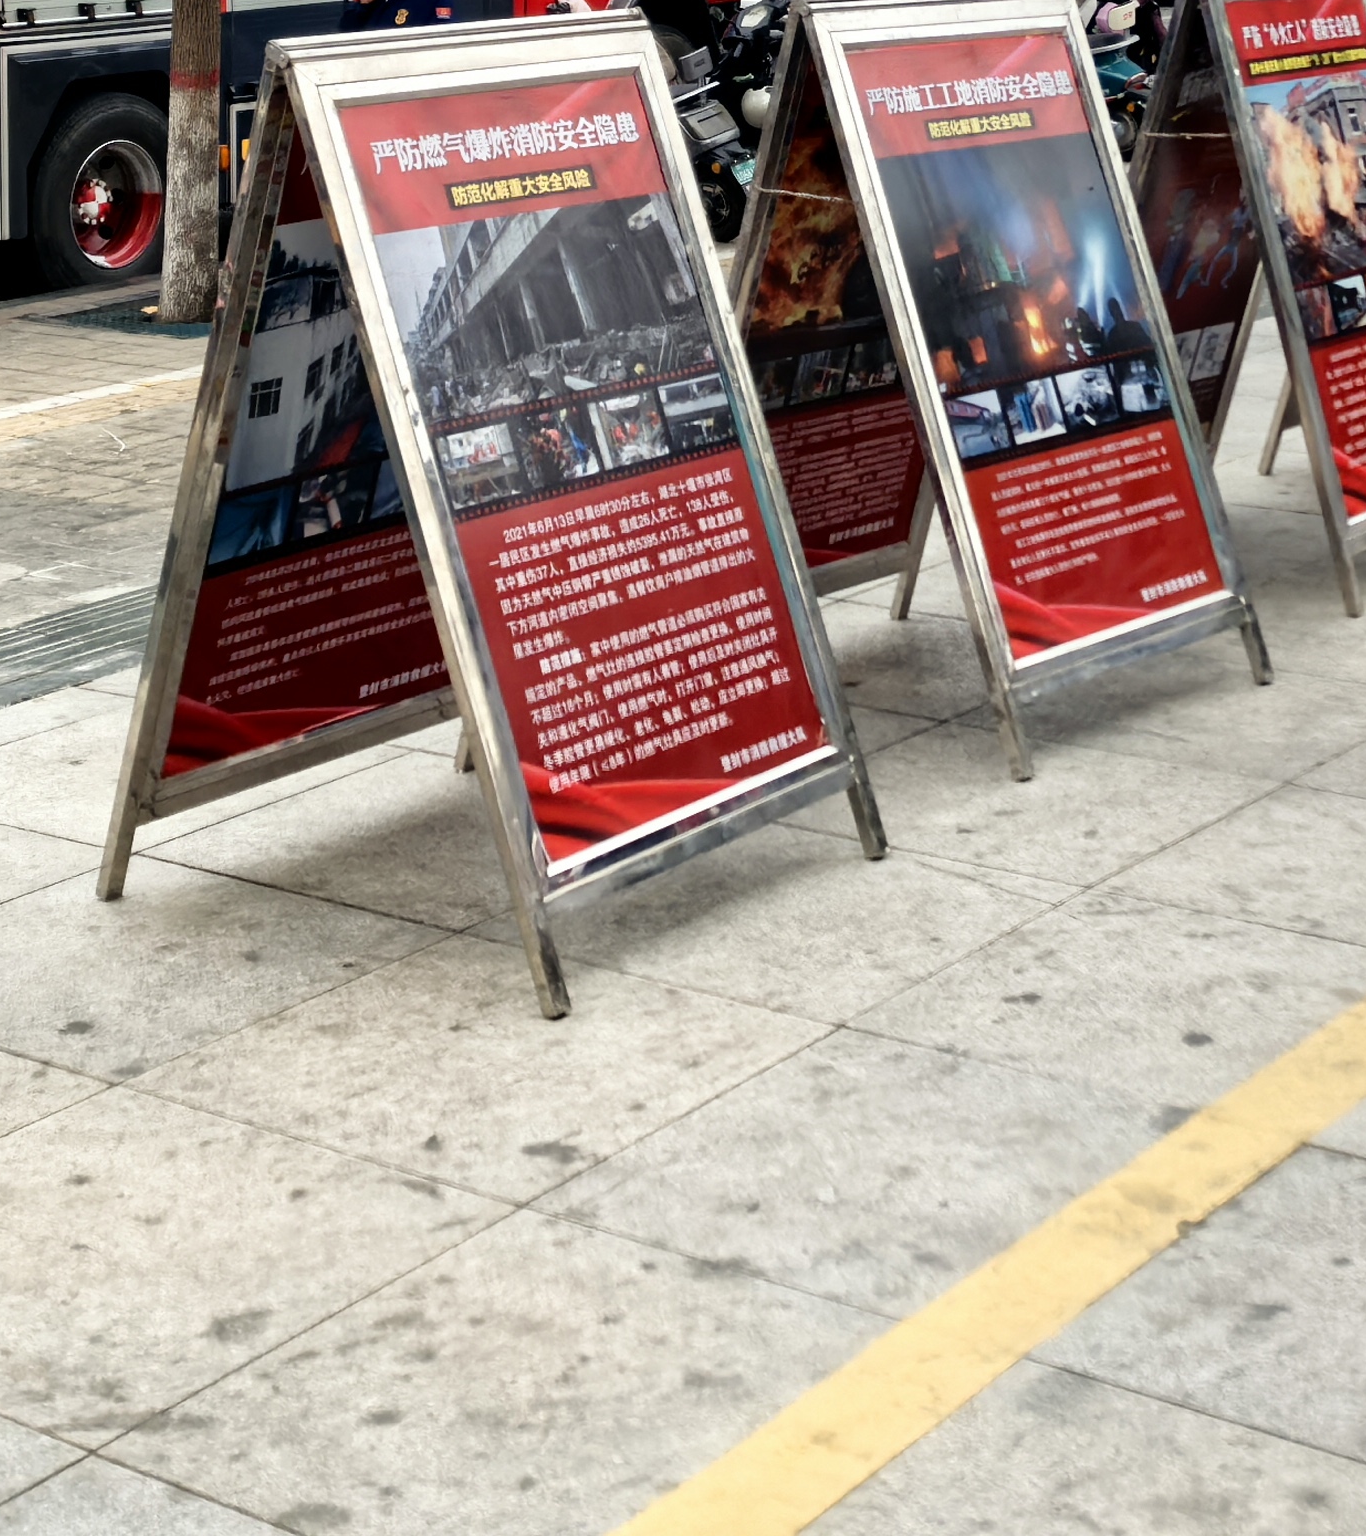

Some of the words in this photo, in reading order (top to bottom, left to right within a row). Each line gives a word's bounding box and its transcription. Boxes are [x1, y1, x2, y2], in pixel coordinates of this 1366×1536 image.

[865, 70, 1074, 116] 严防施工工地消防安全隐患
[370, 111, 639, 174] 严防燃气爆炸消防安全隐患
[451, 169, 591, 206] 防范化解重大安全风险
